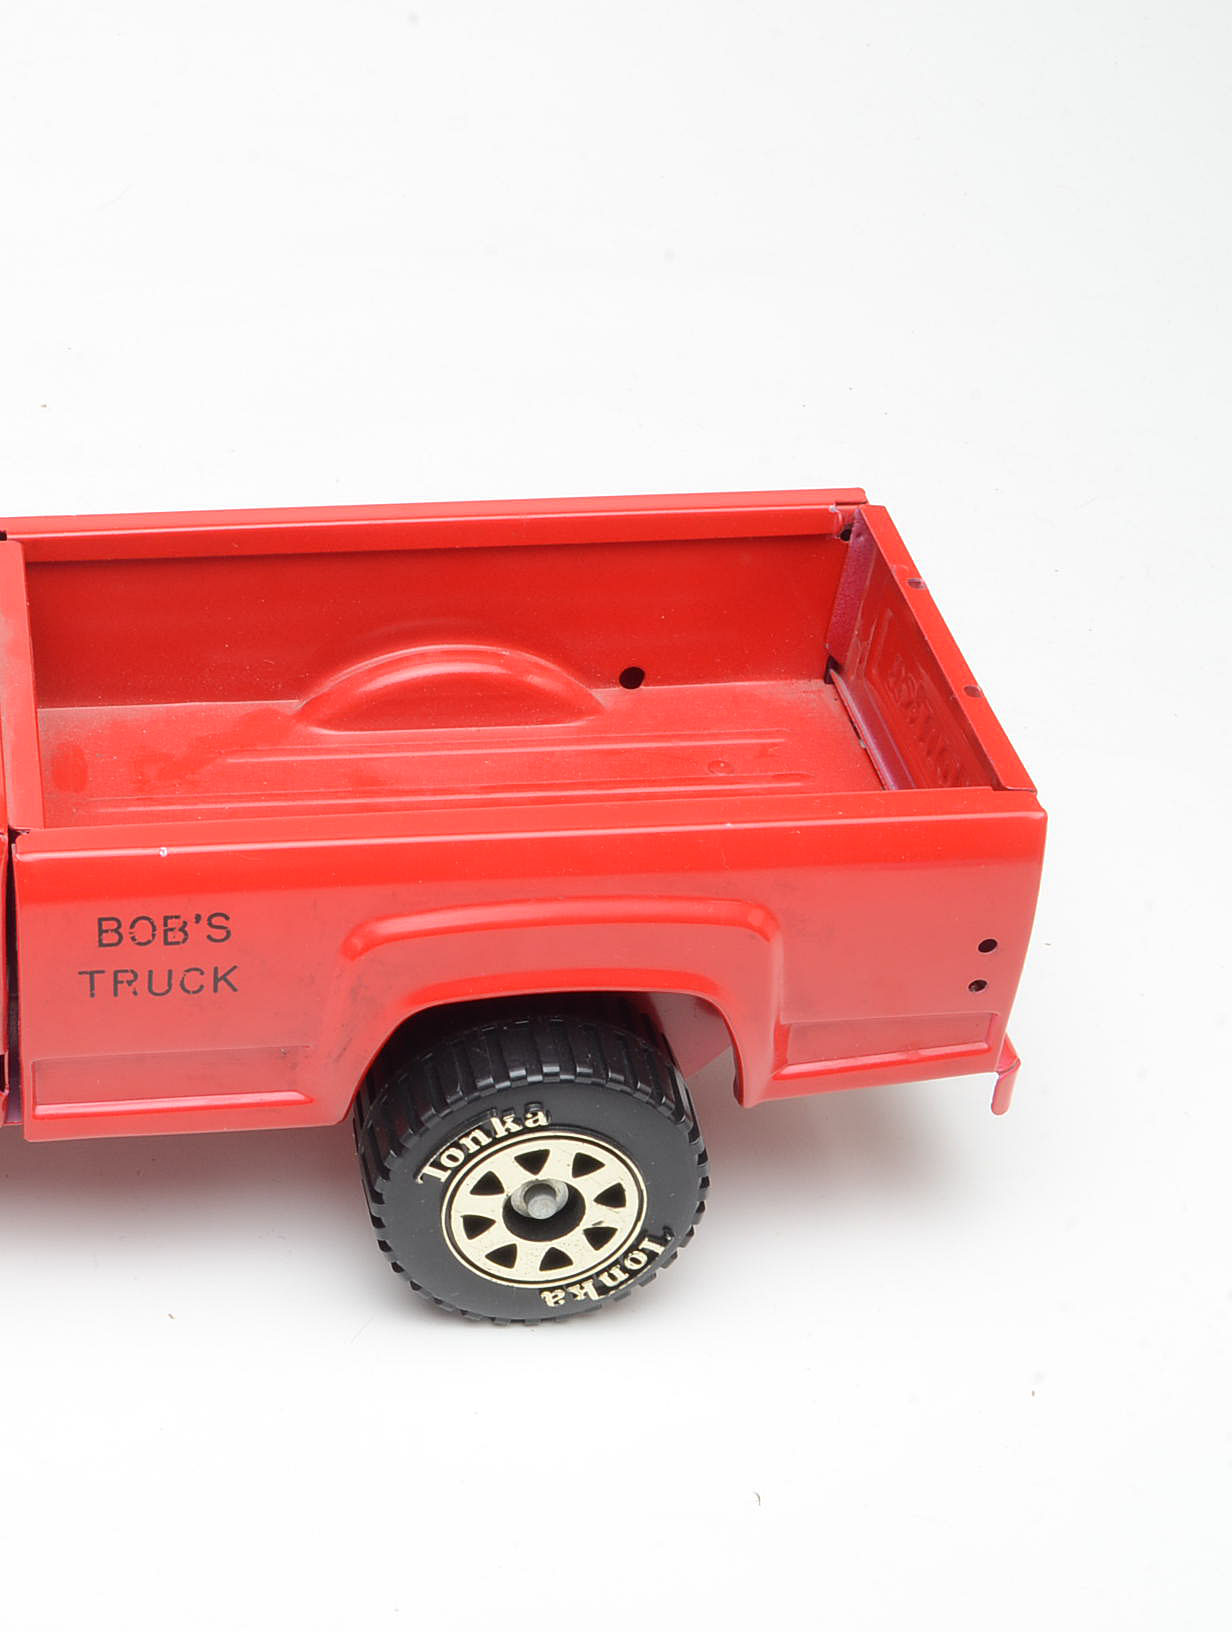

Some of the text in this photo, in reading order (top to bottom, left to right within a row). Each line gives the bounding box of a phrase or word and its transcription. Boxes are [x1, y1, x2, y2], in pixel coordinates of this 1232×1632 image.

[97, 911, 231, 948] BOB'S
[78, 965, 238, 998] TRUCK
[415, 1108, 550, 1185] Tonka
[539, 1230, 672, 1308] Tonka
